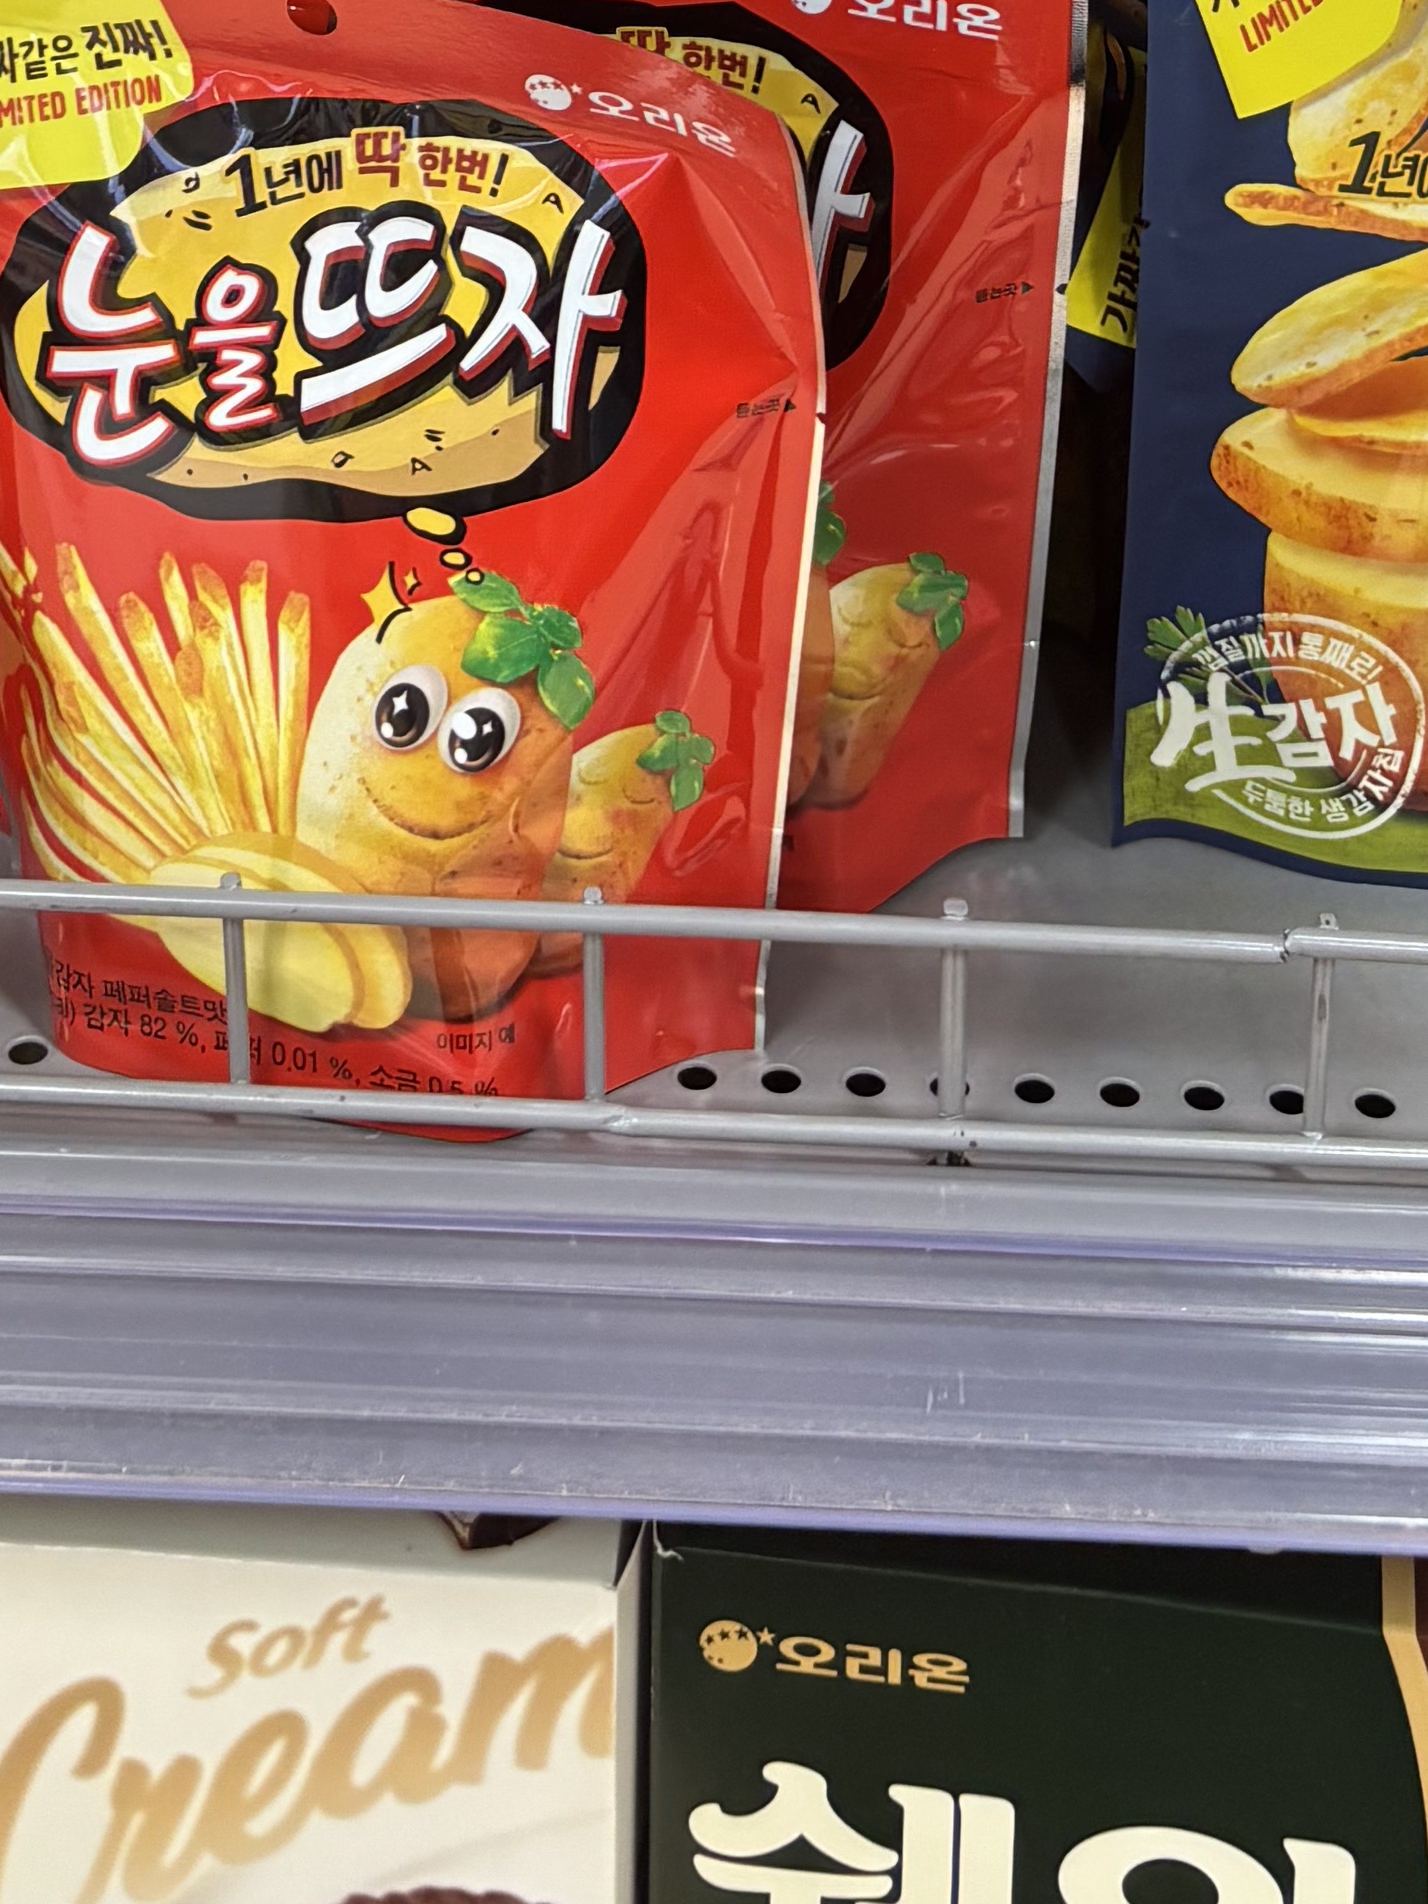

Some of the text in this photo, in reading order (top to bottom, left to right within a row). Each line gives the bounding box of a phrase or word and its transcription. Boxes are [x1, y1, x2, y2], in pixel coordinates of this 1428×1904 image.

[82, 18, 172, 67] 진짜!
[74, 75, 162, 116] EDITION
[587, 86, 738, 155] 오리온
[225, 128, 506, 217] 1년에 딱 한번!
[1298, 631, 1382, 680] 통째로!
[1239, 746, 1406, 825] 두툼한 생감자칩
[102, 972, 228, 1024] 페퍼솔트맛
[84, 1003, 418, 1093] 감자 82 %, 0.01 %, 소금
[436, 1021, 517, 1054] 이미지 예
[187, 1595, 392, 1701] Soft
[775, 1634, 972, 1695] 오리온
